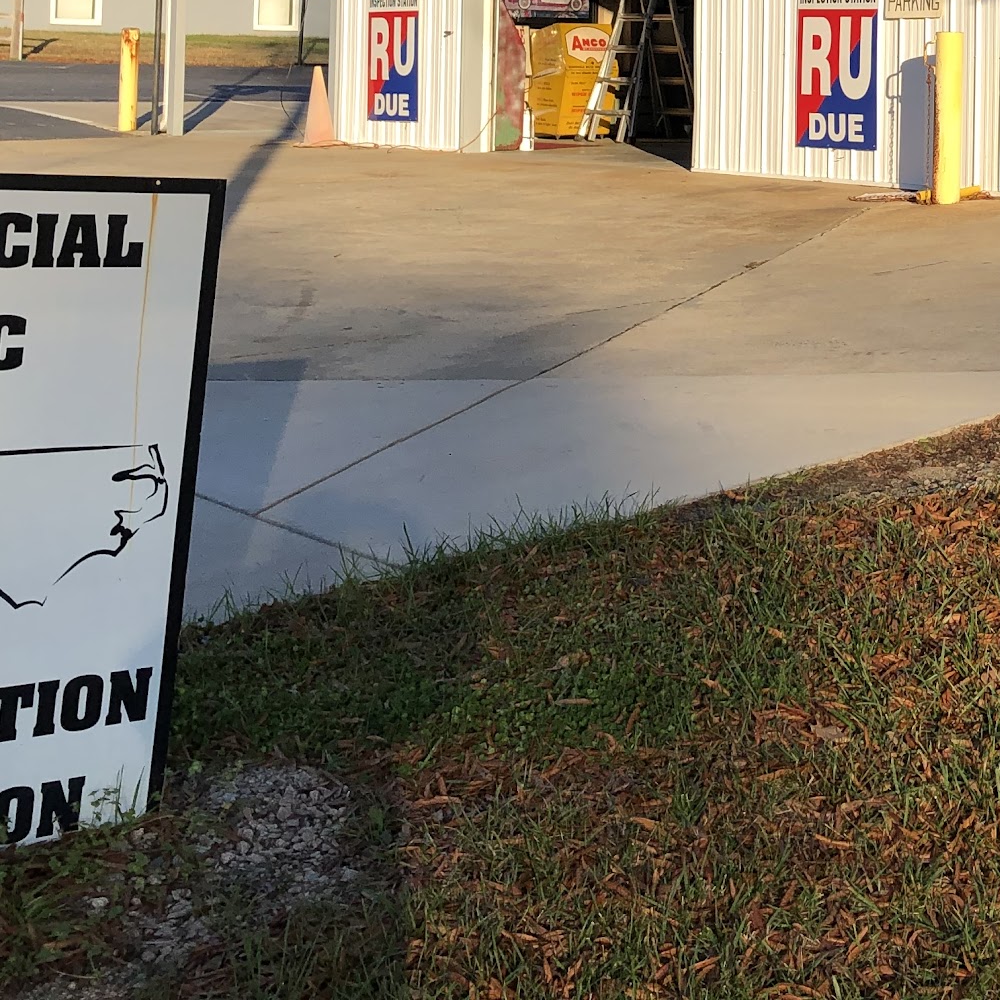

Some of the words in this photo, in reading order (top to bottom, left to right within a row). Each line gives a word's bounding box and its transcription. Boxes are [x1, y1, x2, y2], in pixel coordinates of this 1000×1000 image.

[370, 15, 416, 81] RU
[571, 35, 607, 51] ANCO
[800, 16, 873, 101] RU
[373, 93, 410, 117] DUE
[808, 112, 865, 144] DUE
[0, 212, 144, 268] CIAL
[0, 666, 153, 743] TION
[0, 776, 87, 845] ON
